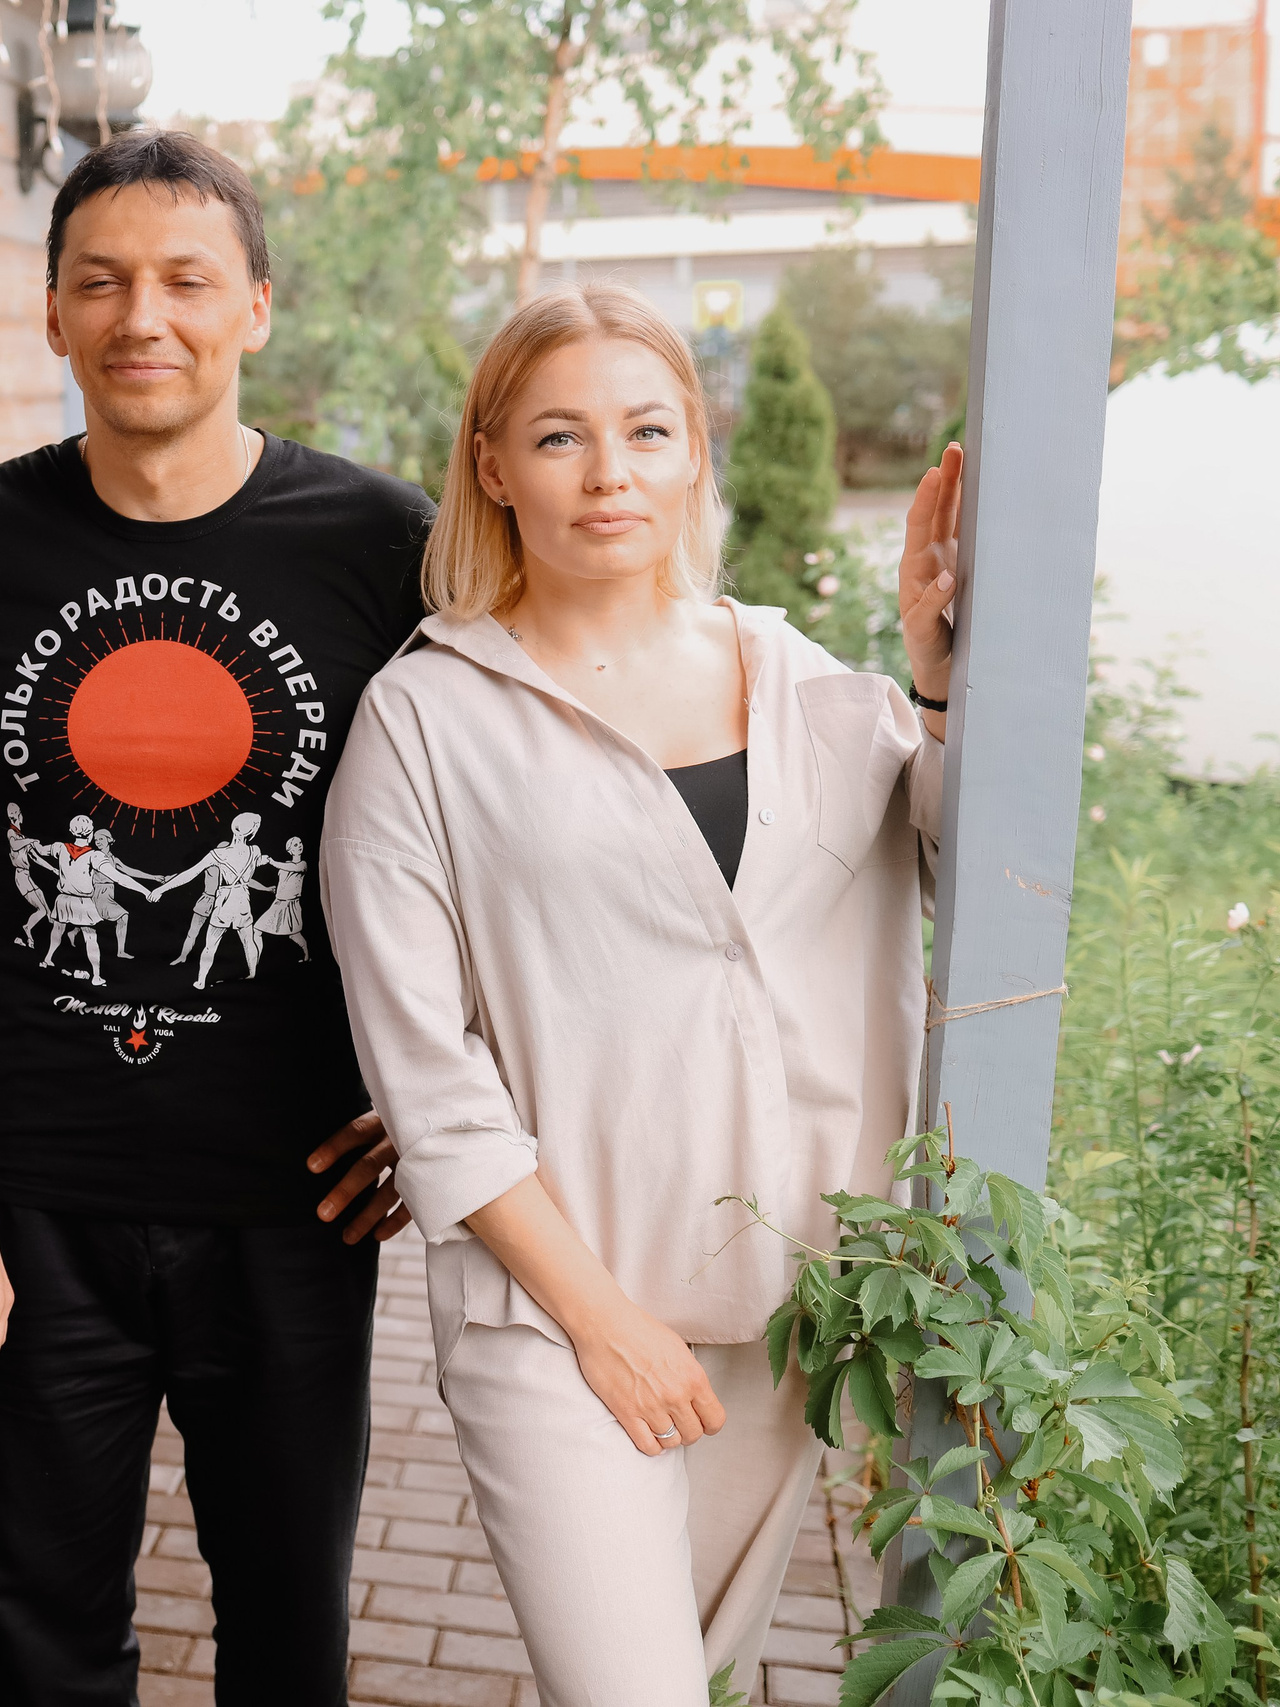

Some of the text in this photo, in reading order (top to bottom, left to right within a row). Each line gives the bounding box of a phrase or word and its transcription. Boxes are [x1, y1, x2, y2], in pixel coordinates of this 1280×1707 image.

[0, 573, 327, 809] ТОЛЬКО РАДОСТЬ ВПЕРЕДИ
[103, 1024, 175, 1037] KALI YUGA
[112, 1037, 163, 1065] RUSSIAN EDITION
